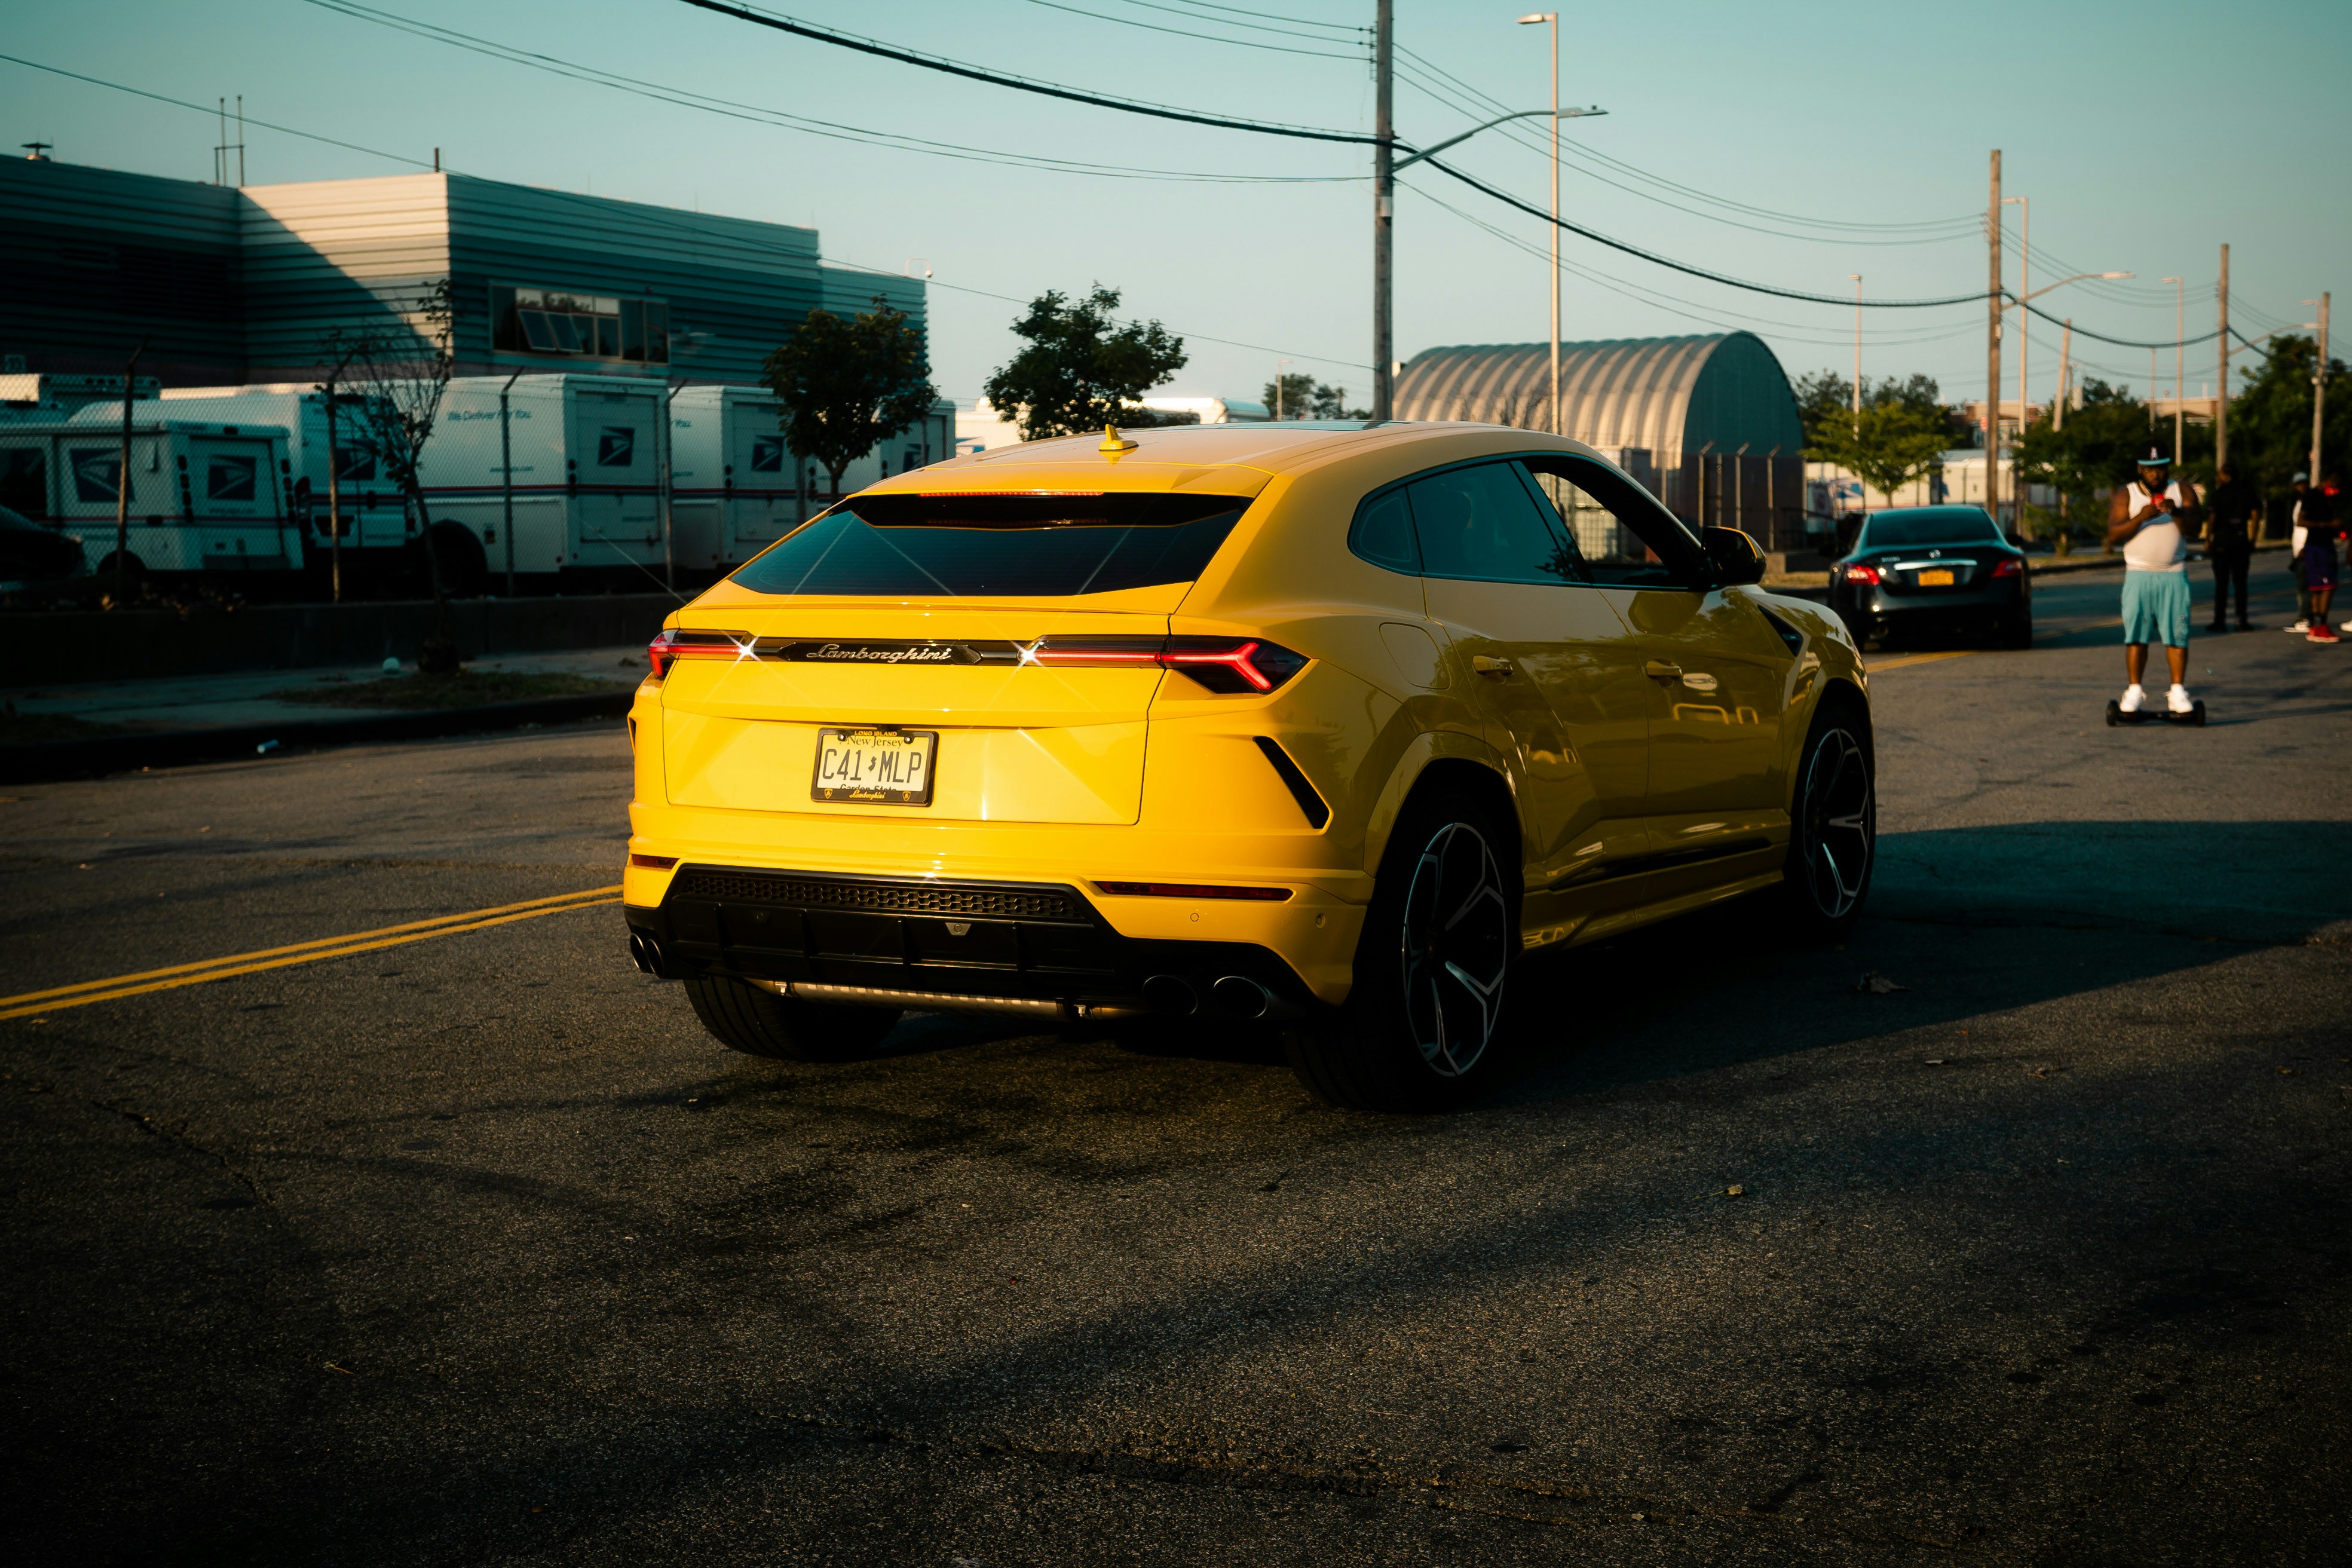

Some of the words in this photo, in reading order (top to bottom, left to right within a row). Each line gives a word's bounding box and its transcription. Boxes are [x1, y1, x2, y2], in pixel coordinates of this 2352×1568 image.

[807, 644, 951, 663] Lamborghini
[847, 736, 871, 745] New
[871, 736, 904, 749] Jersey
[822, 749, 862, 780] C41
[878, 751, 922, 783] MLP
[849, 789, 886, 800] Lamborghini
